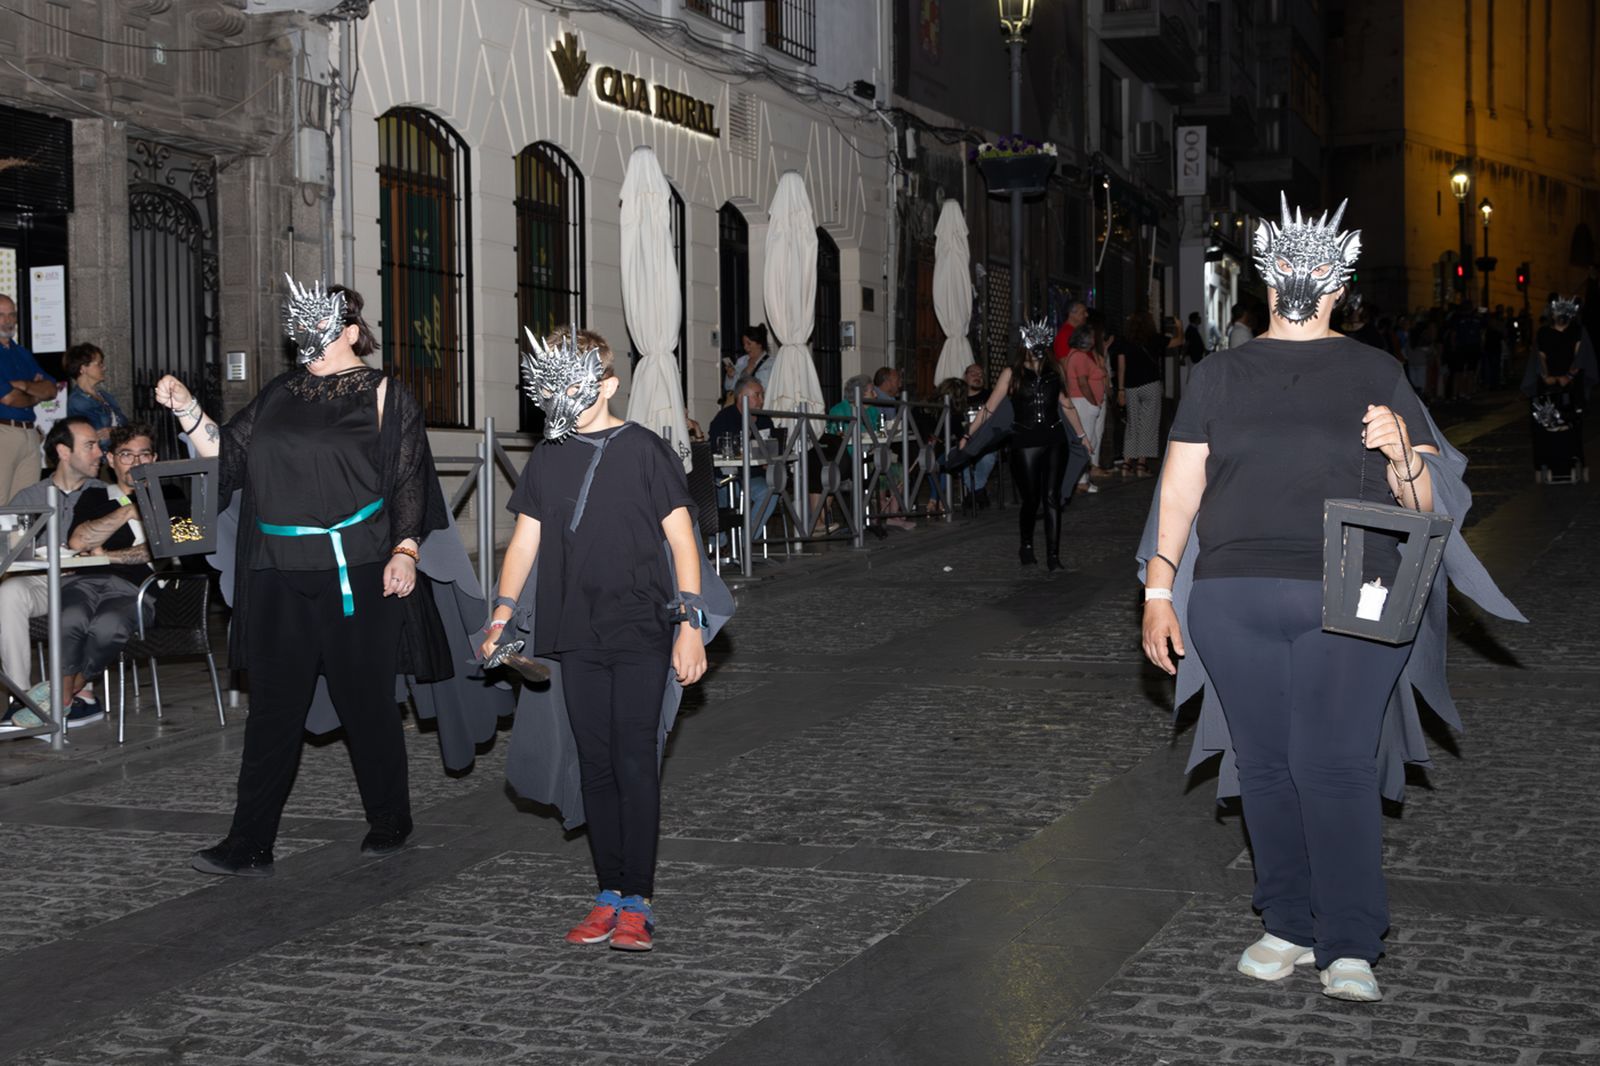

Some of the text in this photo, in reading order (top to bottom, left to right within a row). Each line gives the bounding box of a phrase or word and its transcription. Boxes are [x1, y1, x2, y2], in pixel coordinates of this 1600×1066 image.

[595, 66, 720, 138] CAJA RURAL
[1184, 130, 1200, 176] ZOO
